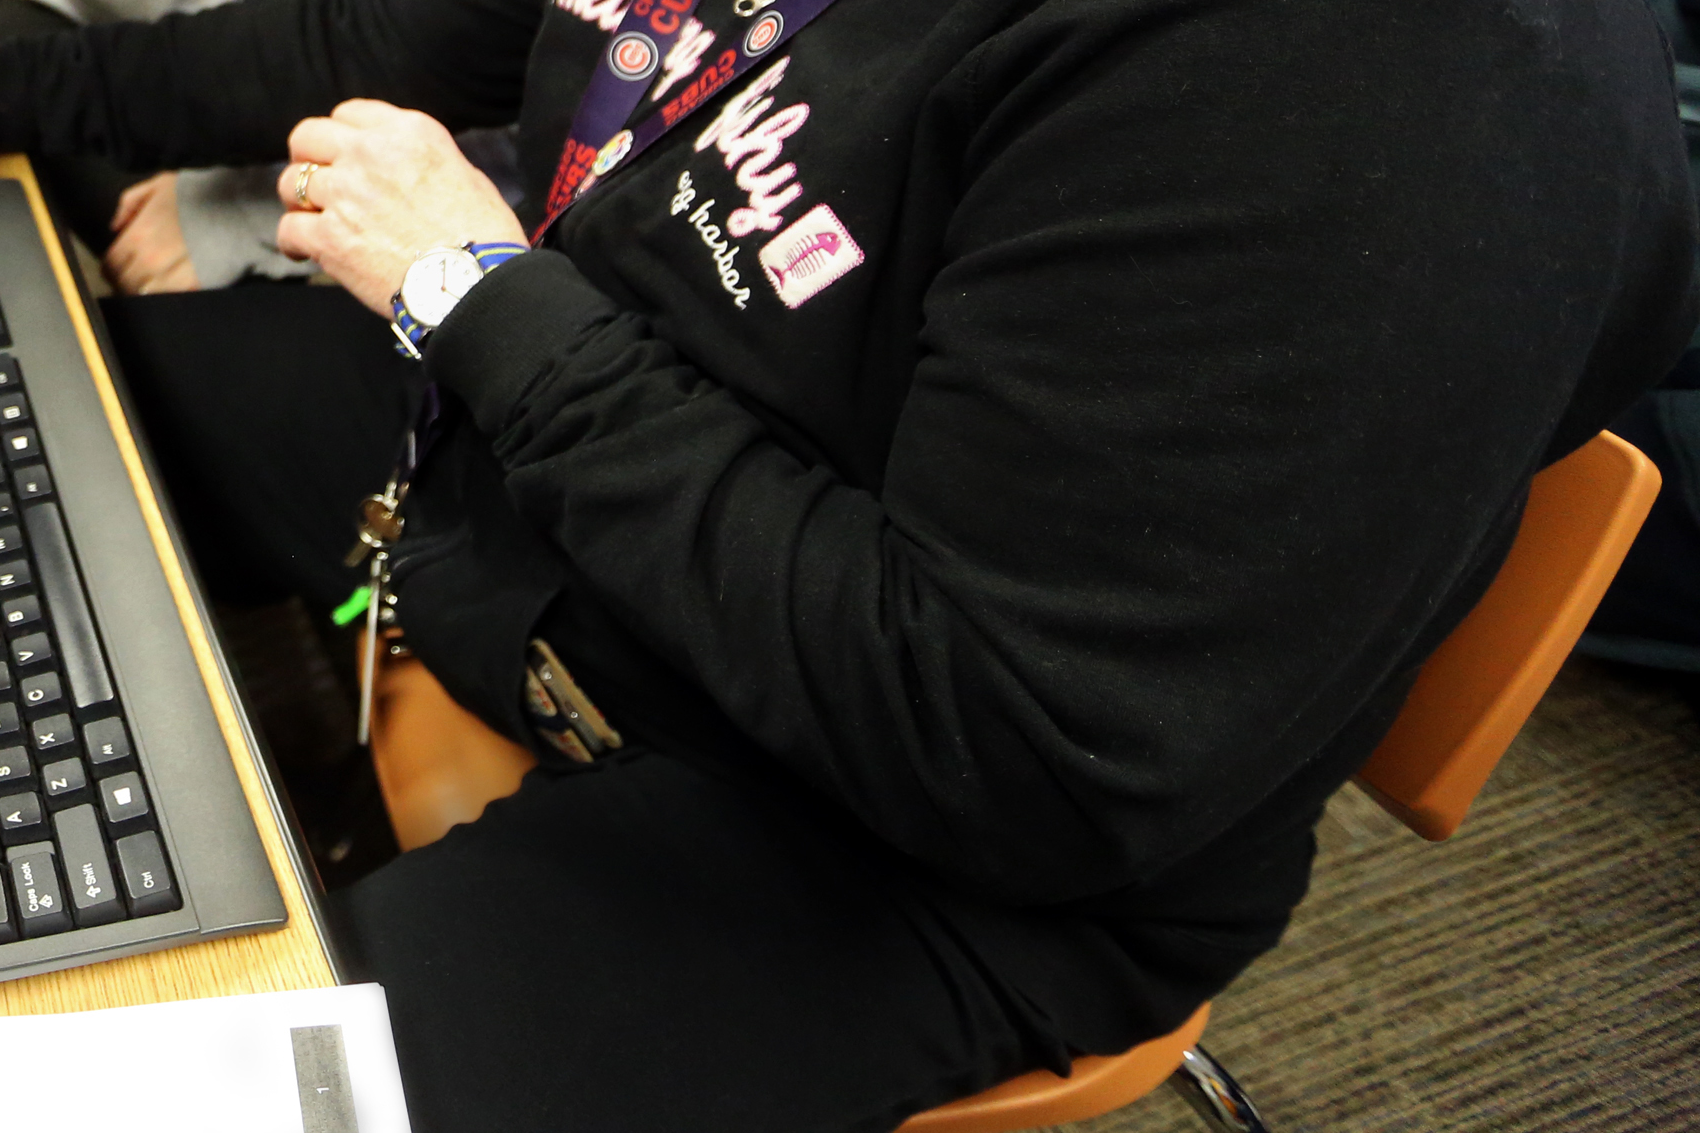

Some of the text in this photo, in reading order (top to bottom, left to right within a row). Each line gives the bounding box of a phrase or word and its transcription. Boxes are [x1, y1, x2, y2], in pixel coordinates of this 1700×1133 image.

[688, 198, 751, 311] harbor
[0, 574, 15, 585] N
[8, 611, 23, 622] B
[18, 651, 33, 661] V
[28, 689, 43, 701] C
[39, 733, 55, 744] X
[51, 778, 67, 790] Z
[7, 811, 22, 822] A
[83, 862, 94, 887] Shift
[141, 872, 154, 888] Ctrl
[21, 862, 41, 912] Caps Lock
[316, 1087, 329, 1095] 1
